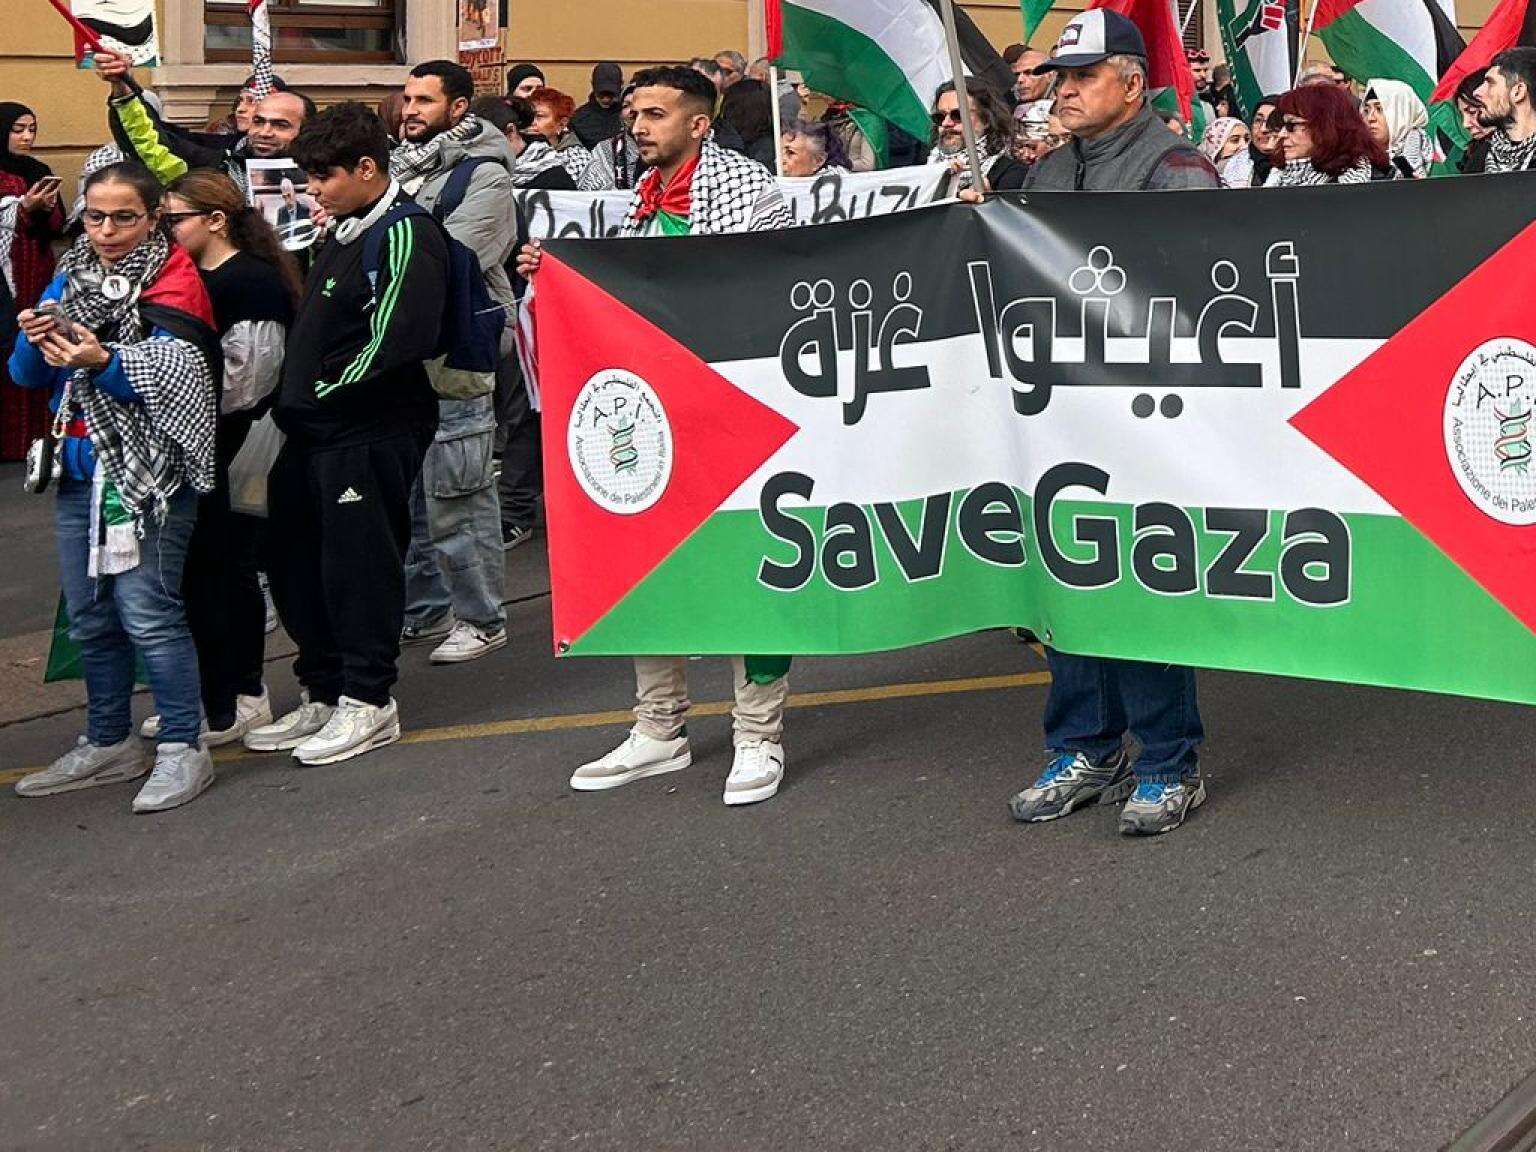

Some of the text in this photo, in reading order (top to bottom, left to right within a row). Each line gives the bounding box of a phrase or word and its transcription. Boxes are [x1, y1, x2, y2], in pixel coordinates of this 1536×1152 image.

[779, 241, 1302, 426] أغيثوا غزة
[593, 397, 646, 428] A.P.I.
[1453, 417, 1492, 500] Associazione
[1492, 494, 1509, 512] dei
[757, 461, 1353, 606] SaveGaza
